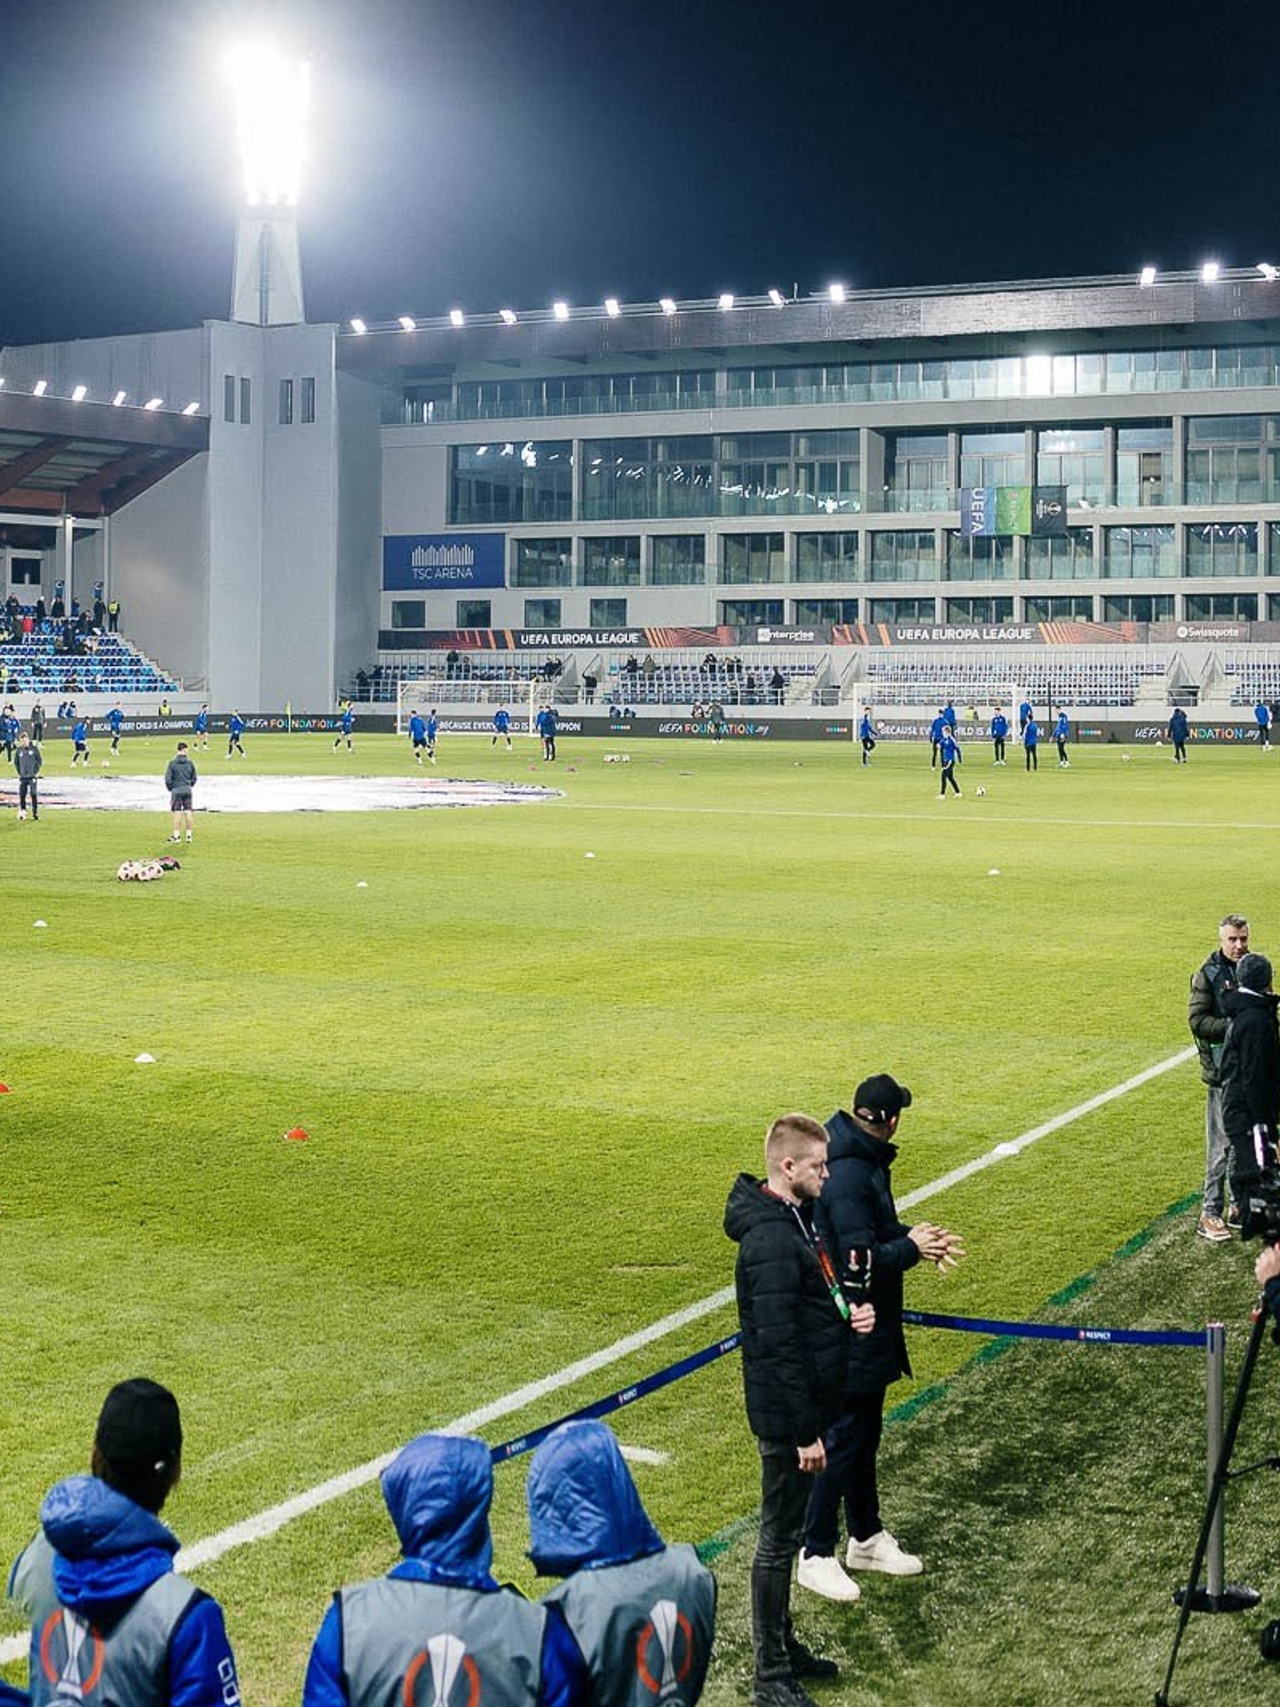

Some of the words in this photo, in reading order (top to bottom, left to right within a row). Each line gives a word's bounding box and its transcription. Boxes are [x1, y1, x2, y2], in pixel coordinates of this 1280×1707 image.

[971, 487, 985, 533] UEFA
[412, 568, 432, 579] TSC
[434, 567, 473, 579] ARENA
[897, 629, 929, 640] UEFA
[932, 628, 980, 640] EUROPA
[983, 628, 1032, 640] LEAGUE
[1188, 627, 1239, 638] Swissquote
[521, 634, 549, 645] UEFA
[552, 633, 593, 645] EUROPA
[596, 632, 639, 644] LEAGUE
[439, 721, 471, 730] BECAUSE
[658, 723, 683, 733] UEFA
[1135, 728, 1162, 738] UEFA
